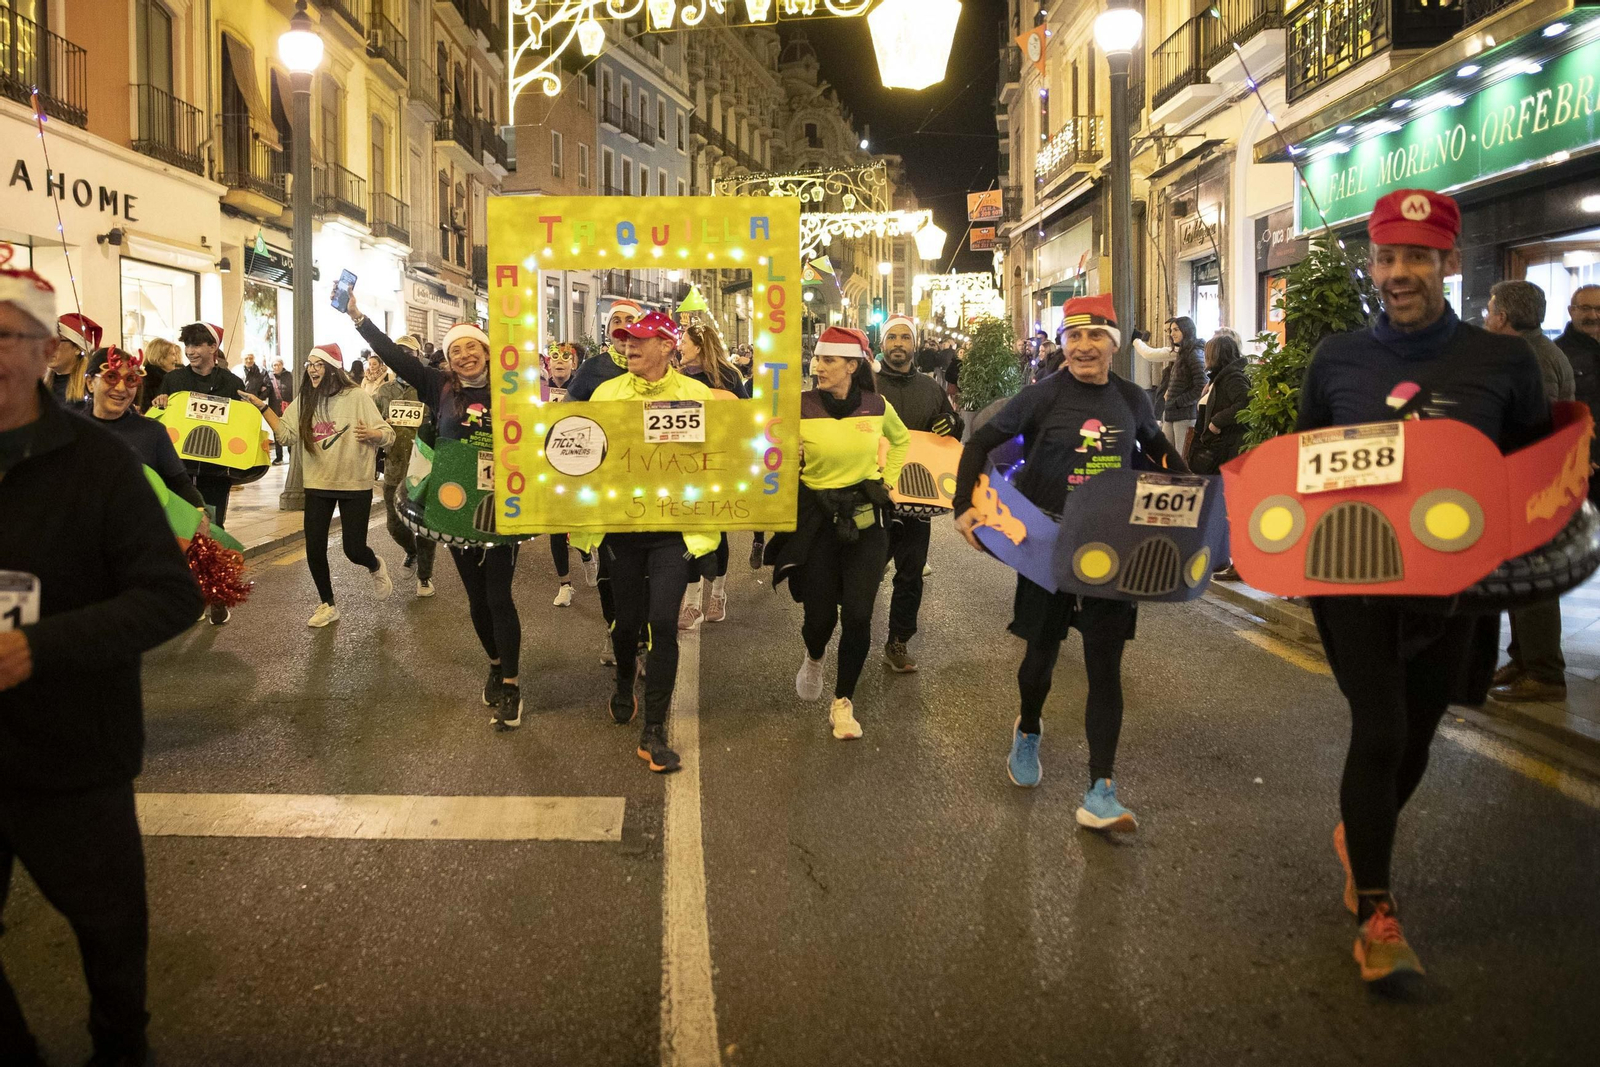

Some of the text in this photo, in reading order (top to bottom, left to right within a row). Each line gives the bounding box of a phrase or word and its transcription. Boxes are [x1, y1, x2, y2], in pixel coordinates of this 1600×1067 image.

[1375, 123, 1467, 188] MORENO
[9, 159, 140, 222] A HOME
[1407, 201, 1426, 214] M
[538, 215, 770, 246] TAQUILLA
[763, 256, 788, 495] LOS TICOS
[496, 265, 526, 518] AUTOS LOCOS
[191, 402, 226, 415] 1971
[391, 409, 421, 419] 2749
[648, 414, 701, 430] 2355
[483, 465, 495, 479] 1
[621, 444, 728, 474] 1 VIAJE
[1308, 446, 1395, 475] 1588
[625, 496, 750, 519] 5 PESETAS
[1142, 492, 1197, 512] 1601
